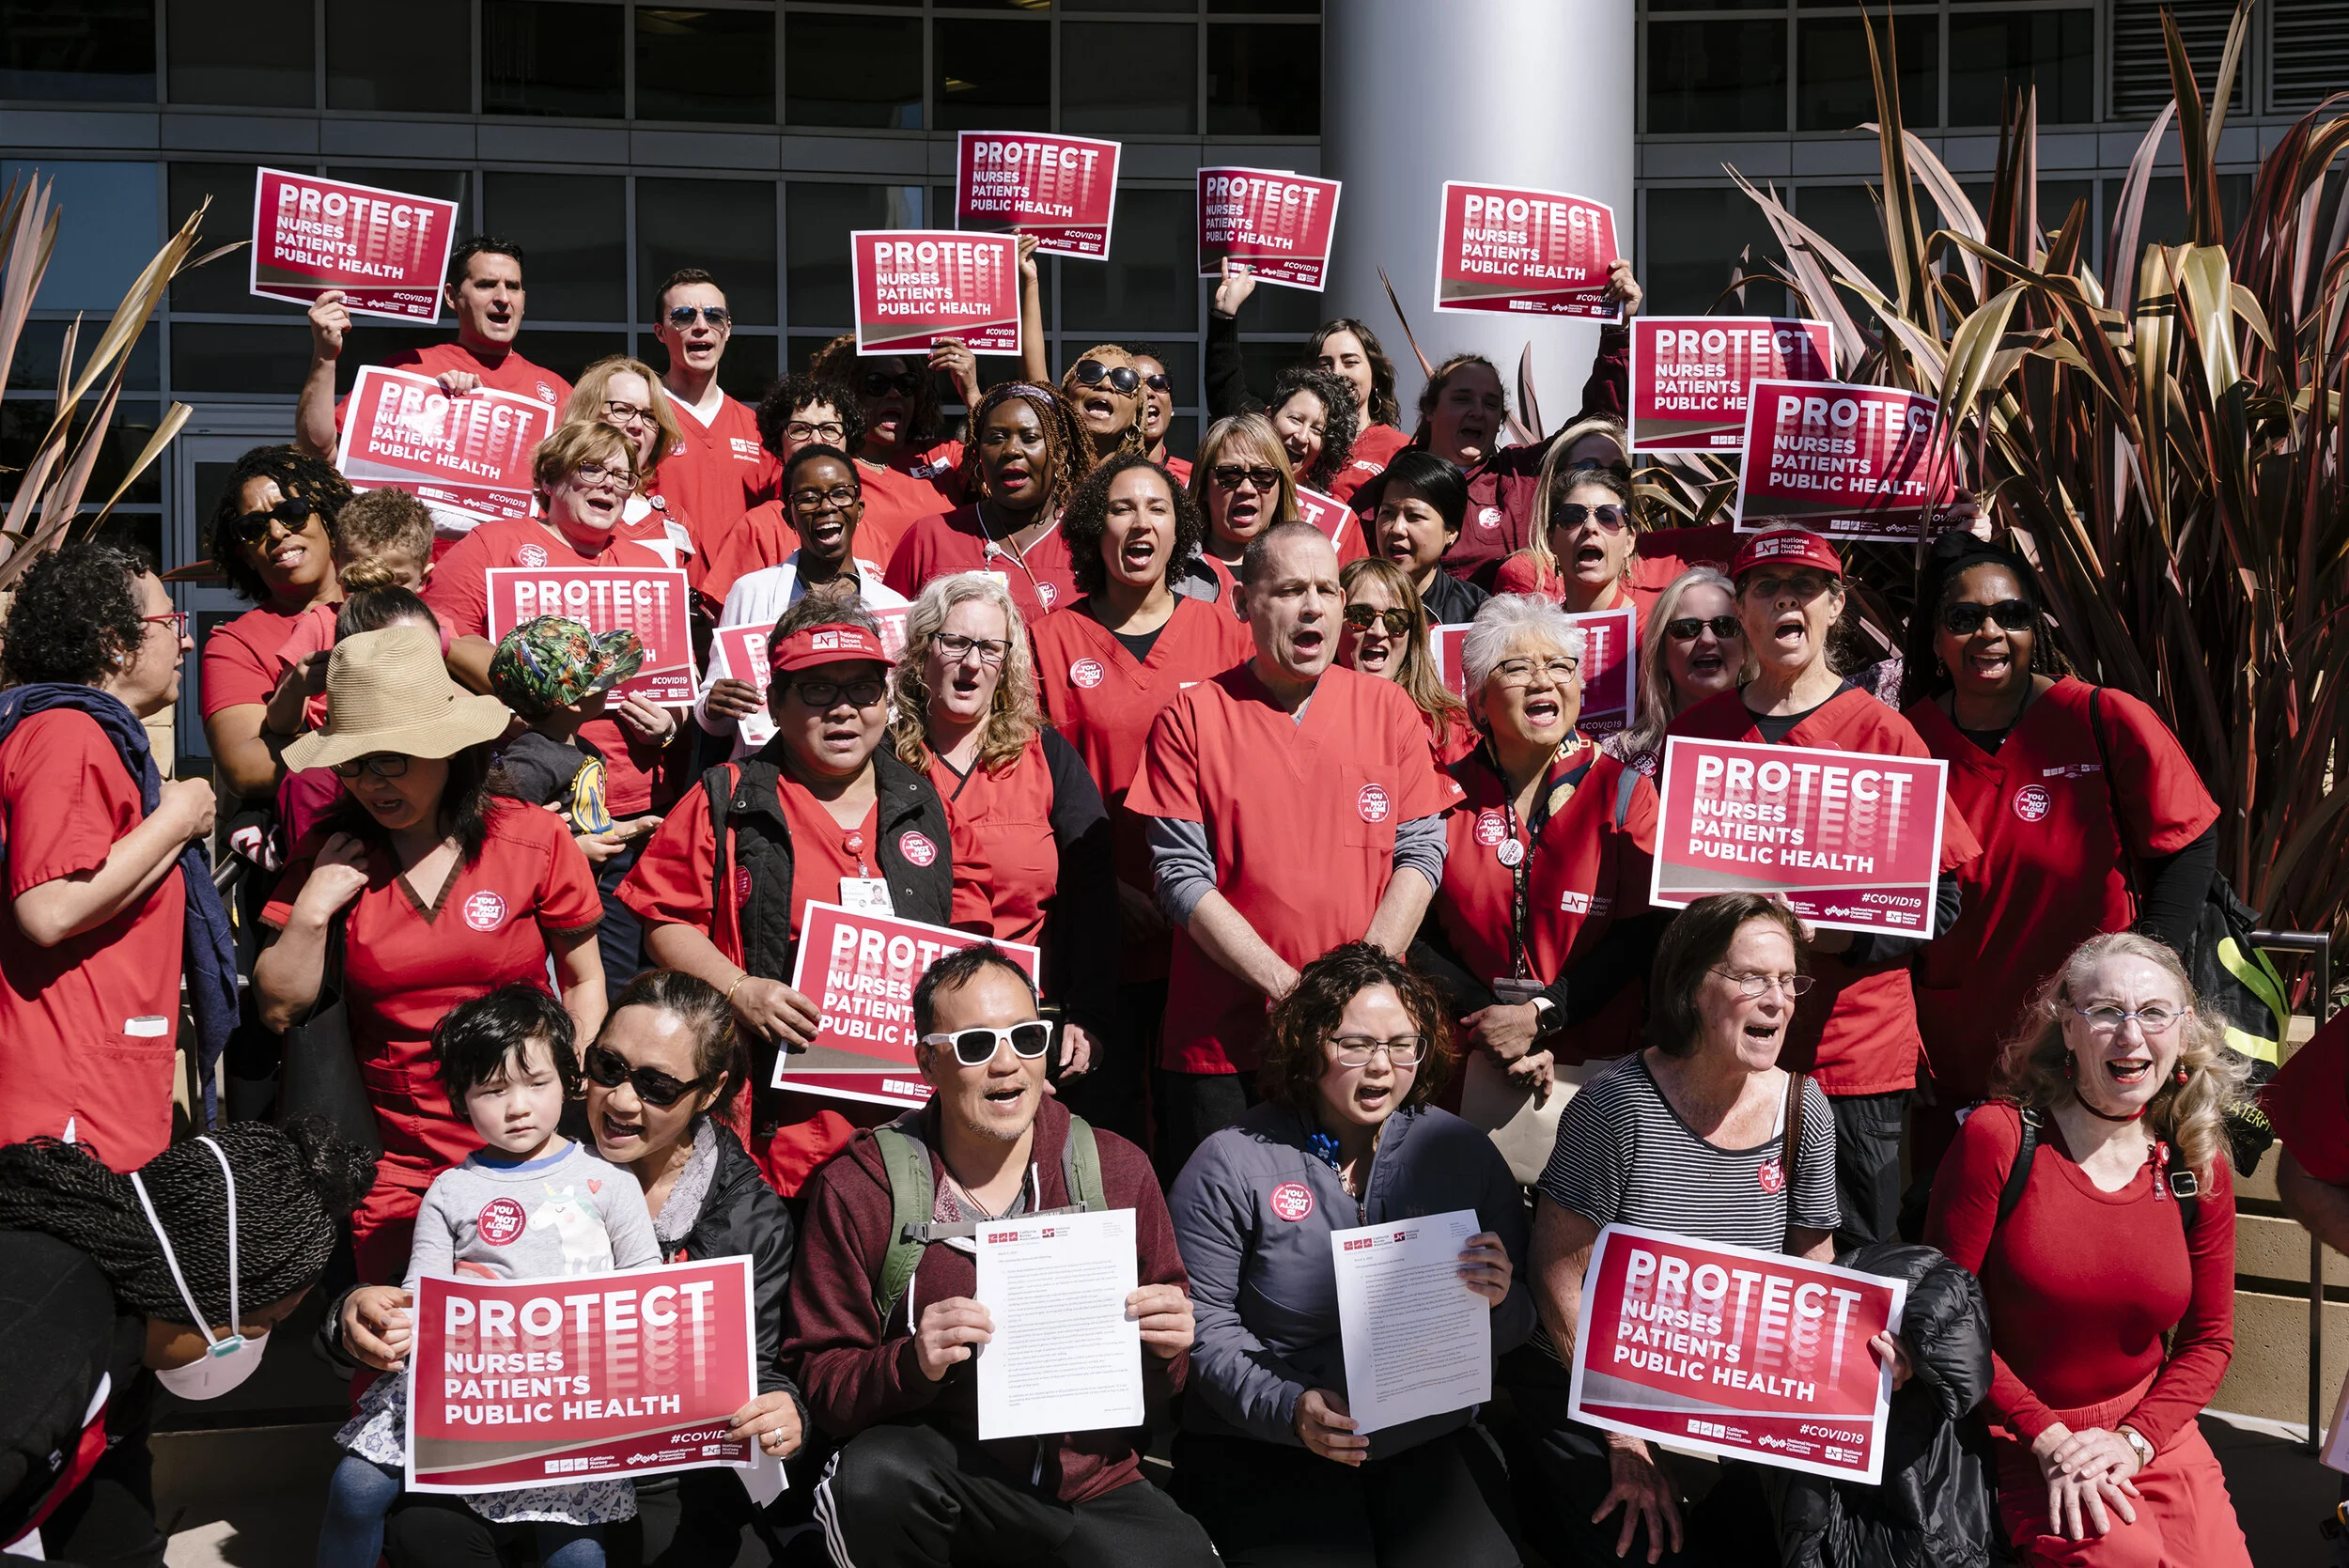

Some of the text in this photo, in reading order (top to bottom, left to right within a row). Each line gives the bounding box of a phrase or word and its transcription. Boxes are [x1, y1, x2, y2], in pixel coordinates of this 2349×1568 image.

[973, 141, 1098, 171] PROTECT
[972, 171, 1019, 183] NURSES
[972, 184, 1030, 198] PATIENTS
[1206, 177, 1320, 207] PROTECT
[278, 182, 434, 231] PROTECT
[971, 198, 1073, 218] PUBLIC HEALTH
[1206, 204, 1244, 216] NURSES
[1465, 194, 1601, 230] PROTECT
[277, 216, 345, 239] NURSES
[1206, 217, 1253, 230] PATIENTS
[275, 230, 357, 256] PATIENTS
[1065, 229, 1102, 241] #COVID19
[1206, 230, 1294, 250] PUBLIC HEALTH
[1463, 227, 1528, 244] NURSES
[874, 241, 1003, 267] PROTECT
[1462, 243, 1540, 261] PATIENTS
[274, 246, 404, 279] PUBLIC HEALTH
[1283, 261, 1319, 273] #COVID19
[1460, 258, 1586, 280] PUBLIC HEALTH
[876, 272, 940, 286] NURSES
[393, 292, 432, 303] #COVID19
[877, 287, 953, 301] PATIENTS
[1576, 294, 1613, 303] #COVID
[878, 302, 991, 316] PUBLIC HEALTH
[986, 328, 1016, 336] #COVID19
[1656, 329, 1813, 354] PROTECT
[1656, 364, 1726, 378] NURSES
[1655, 380, 1741, 394] PATIENTS
[380, 380, 534, 430] PROTECT
[1654, 396, 1719, 411] PUBLIC
[371, 426, 456, 452] PATIENTS
[1773, 435, 1857, 455] NURSES
[367, 441, 502, 480] PUBLIC HEALTH
[1770, 453, 1872, 474] PATIENTS
[1769, 472, 1930, 497] PUBLIC HEALTH
[489, 492, 527, 508] #COVID19
[1781, 536, 1810, 545] National
[514, 580, 670, 606] PROTECT
[839, 630, 863, 639] National
[652, 675, 688, 685] #COVID19
[1579, 721, 1622, 730] #COVID19
[1696, 754, 1913, 805] PROTECT
[1693, 798, 1787, 822] NURSES
[2020, 805, 2044, 814] ALONE
[1484, 818, 1501, 827] YOU
[1690, 818, 1805, 846] PATIENTS
[1688, 838, 1874, 874] PUBLIC HEALTH
[476, 896, 496, 905] YOU
[1861, 893, 1921, 908] #COVID19
[831, 923, 962, 970] PROT
[826, 970, 911, 1001] NURSES
[822, 992, 916, 1023] PATIENT
[817, 1015, 898, 1045] PUBLIC
[1285, 1188, 1304, 1198] YOU
[1287, 1198, 1308, 1206] NOT
[493, 1204, 514, 1215] YOU
[1279, 1202, 1306, 1211] ALONE
[485, 1221, 514, 1232] ALONE
[494, 1214, 519, 1224] NOT
[1624, 1248, 1862, 1323] PROTECT
[444, 1280, 715, 1338] PROTECT
[1620, 1299, 1722, 1336] NURSES
[1616, 1321, 1742, 1364] PATIENTS
[444, 1351, 565, 1374] NURSES
[1613, 1343, 1815, 1403] PUBLIC HEALTH
[444, 1374, 591, 1399] PATIENTS
[444, 1393, 680, 1425] PUBLIC HEALTH
[670, 1429, 726, 1444] #COVID
[1726, 1425, 1749, 1434] California
[1799, 1423, 1864, 1445] #COVID19
